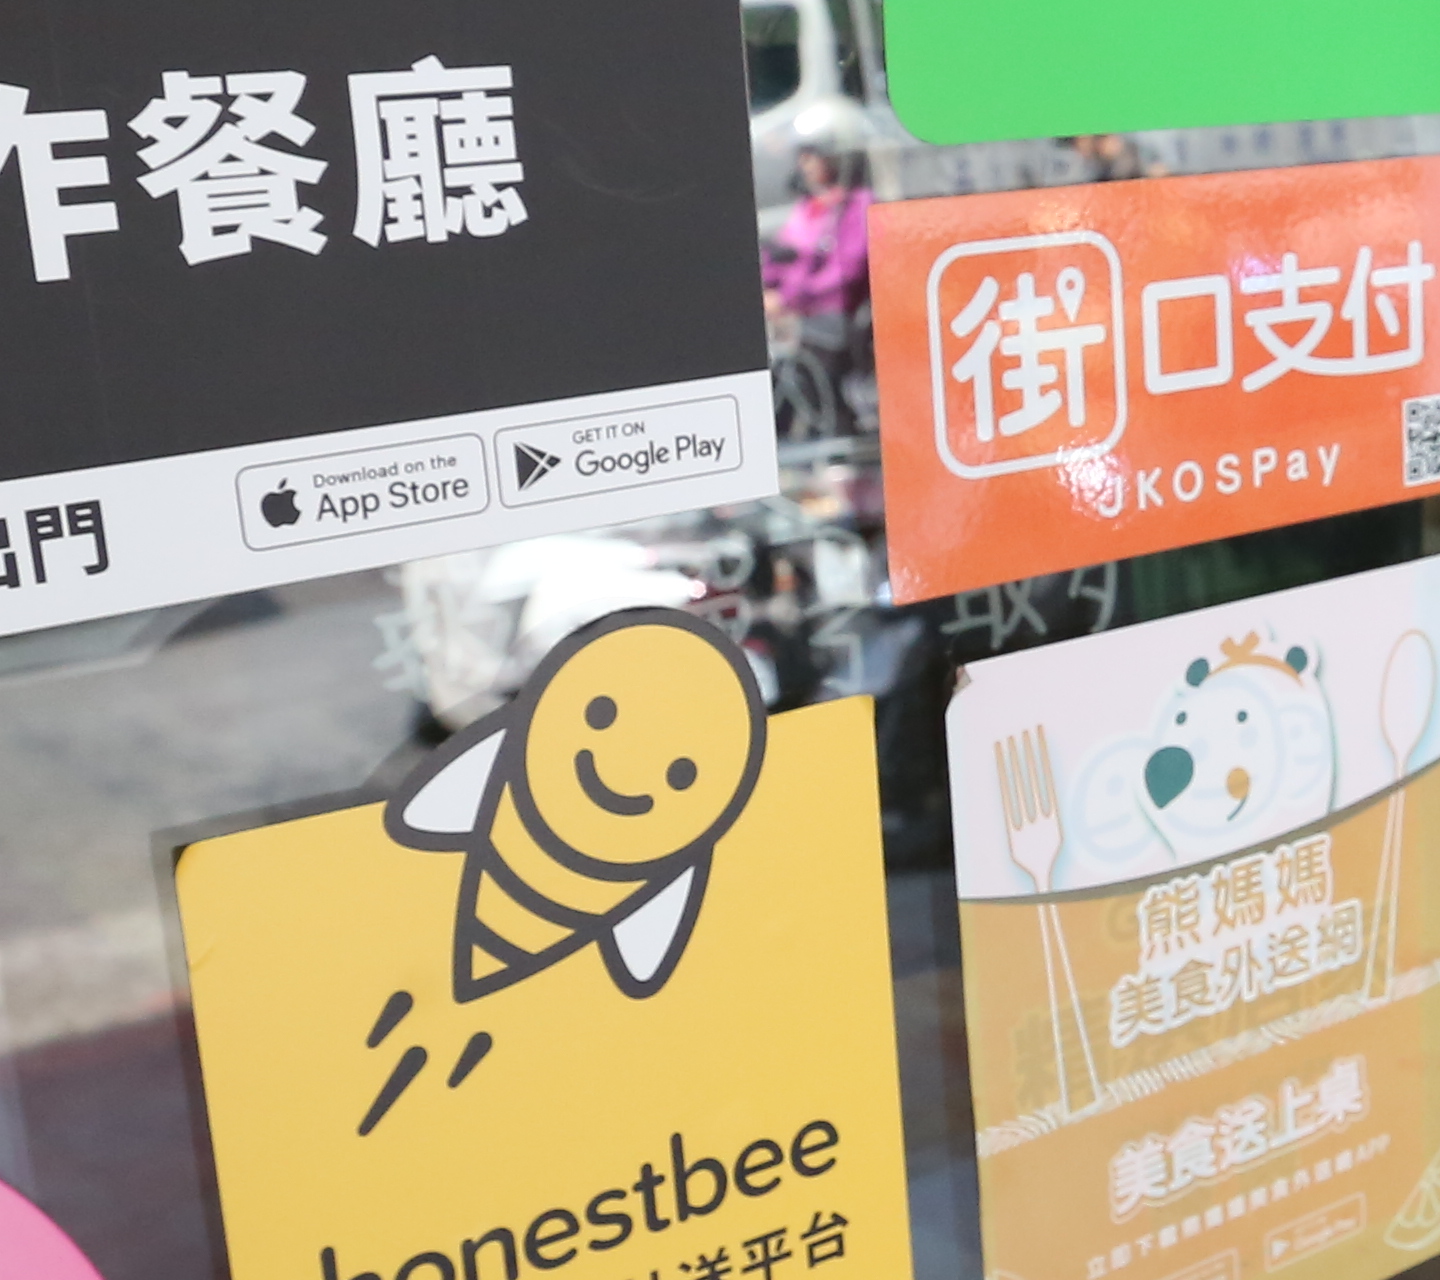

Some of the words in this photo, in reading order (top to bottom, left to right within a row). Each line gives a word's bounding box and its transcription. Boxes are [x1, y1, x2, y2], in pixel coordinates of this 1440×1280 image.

[572, 426, 602, 445] GET
[605, 424, 618, 441] IT
[621, 421, 646, 438] ON
[574, 441, 671, 477] Google
[675, 433, 726, 463] Play
[312, 462, 399, 489] Download
[403, 459, 426, 474] on
[430, 454, 458, 470] the
[315, 482, 381, 524] App
[388, 474, 470, 508] Store
[1142, 835, 1331, 962] 熊媽媽
[1113, 902, 1359, 1045] 美食外送網
[1111, 1058, 1364, 1219] 美食送上桌
